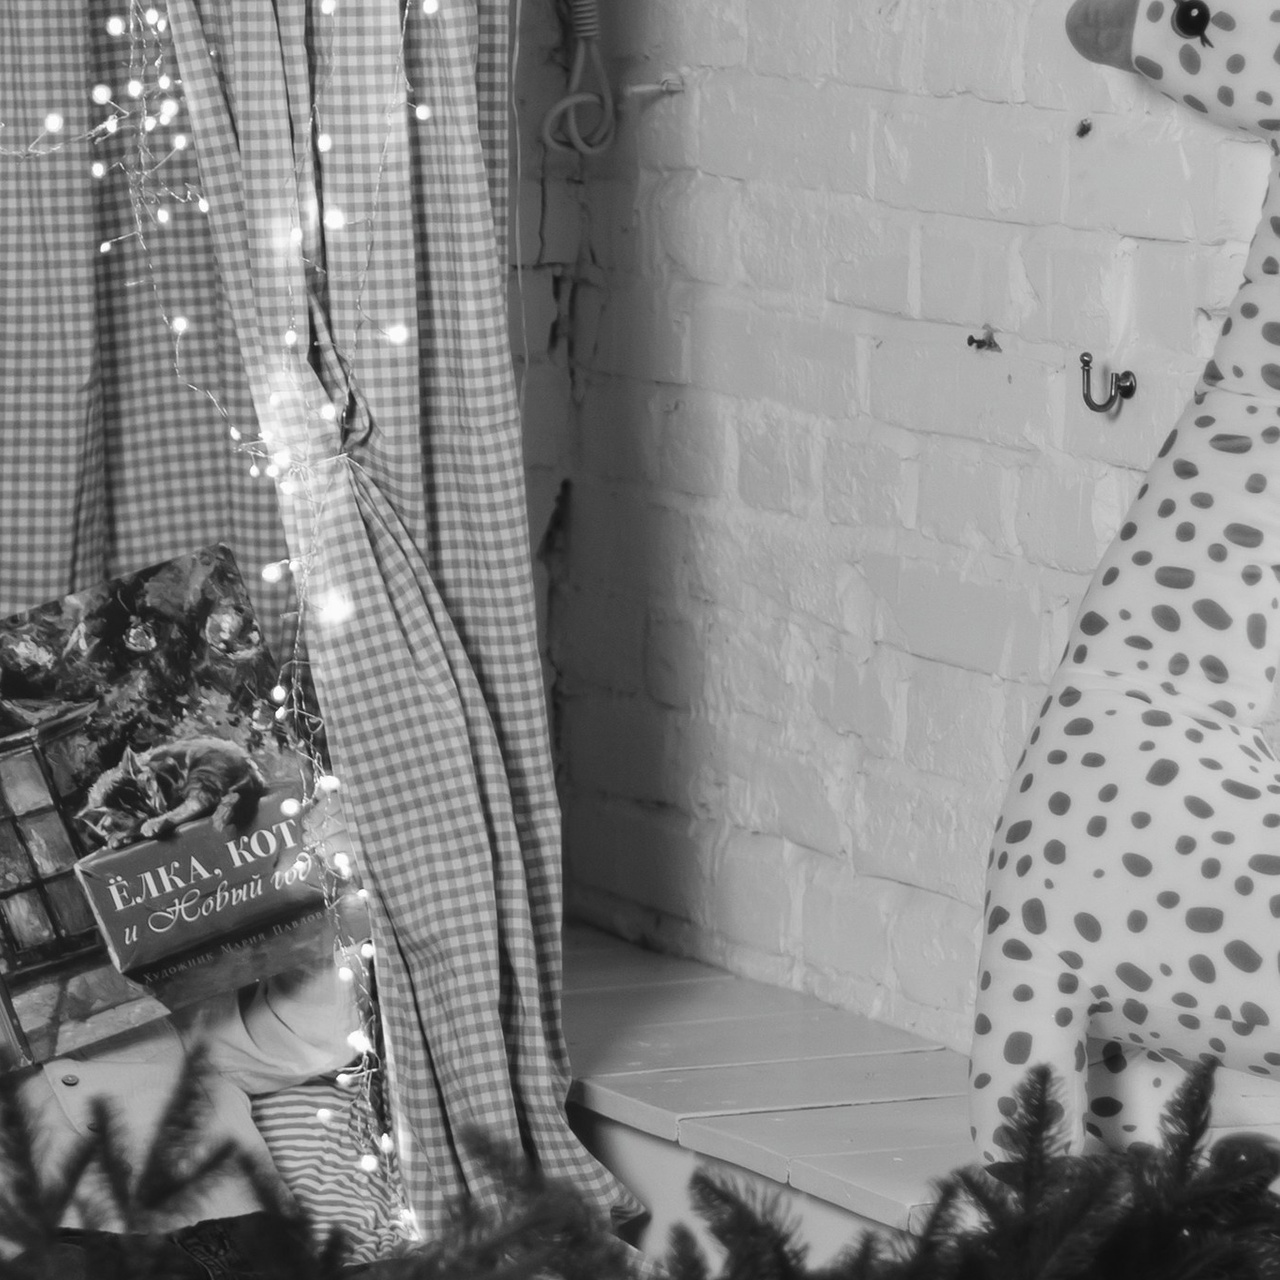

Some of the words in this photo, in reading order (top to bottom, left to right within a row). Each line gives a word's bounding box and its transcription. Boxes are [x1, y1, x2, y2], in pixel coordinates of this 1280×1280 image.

[107, 856, 222, 911] ЁЛКА,
[225, 819, 296, 868] КОТ
[125, 925, 138, 945] и
[148, 874, 262, 932] Новый
[270, 852, 312, 890] год
